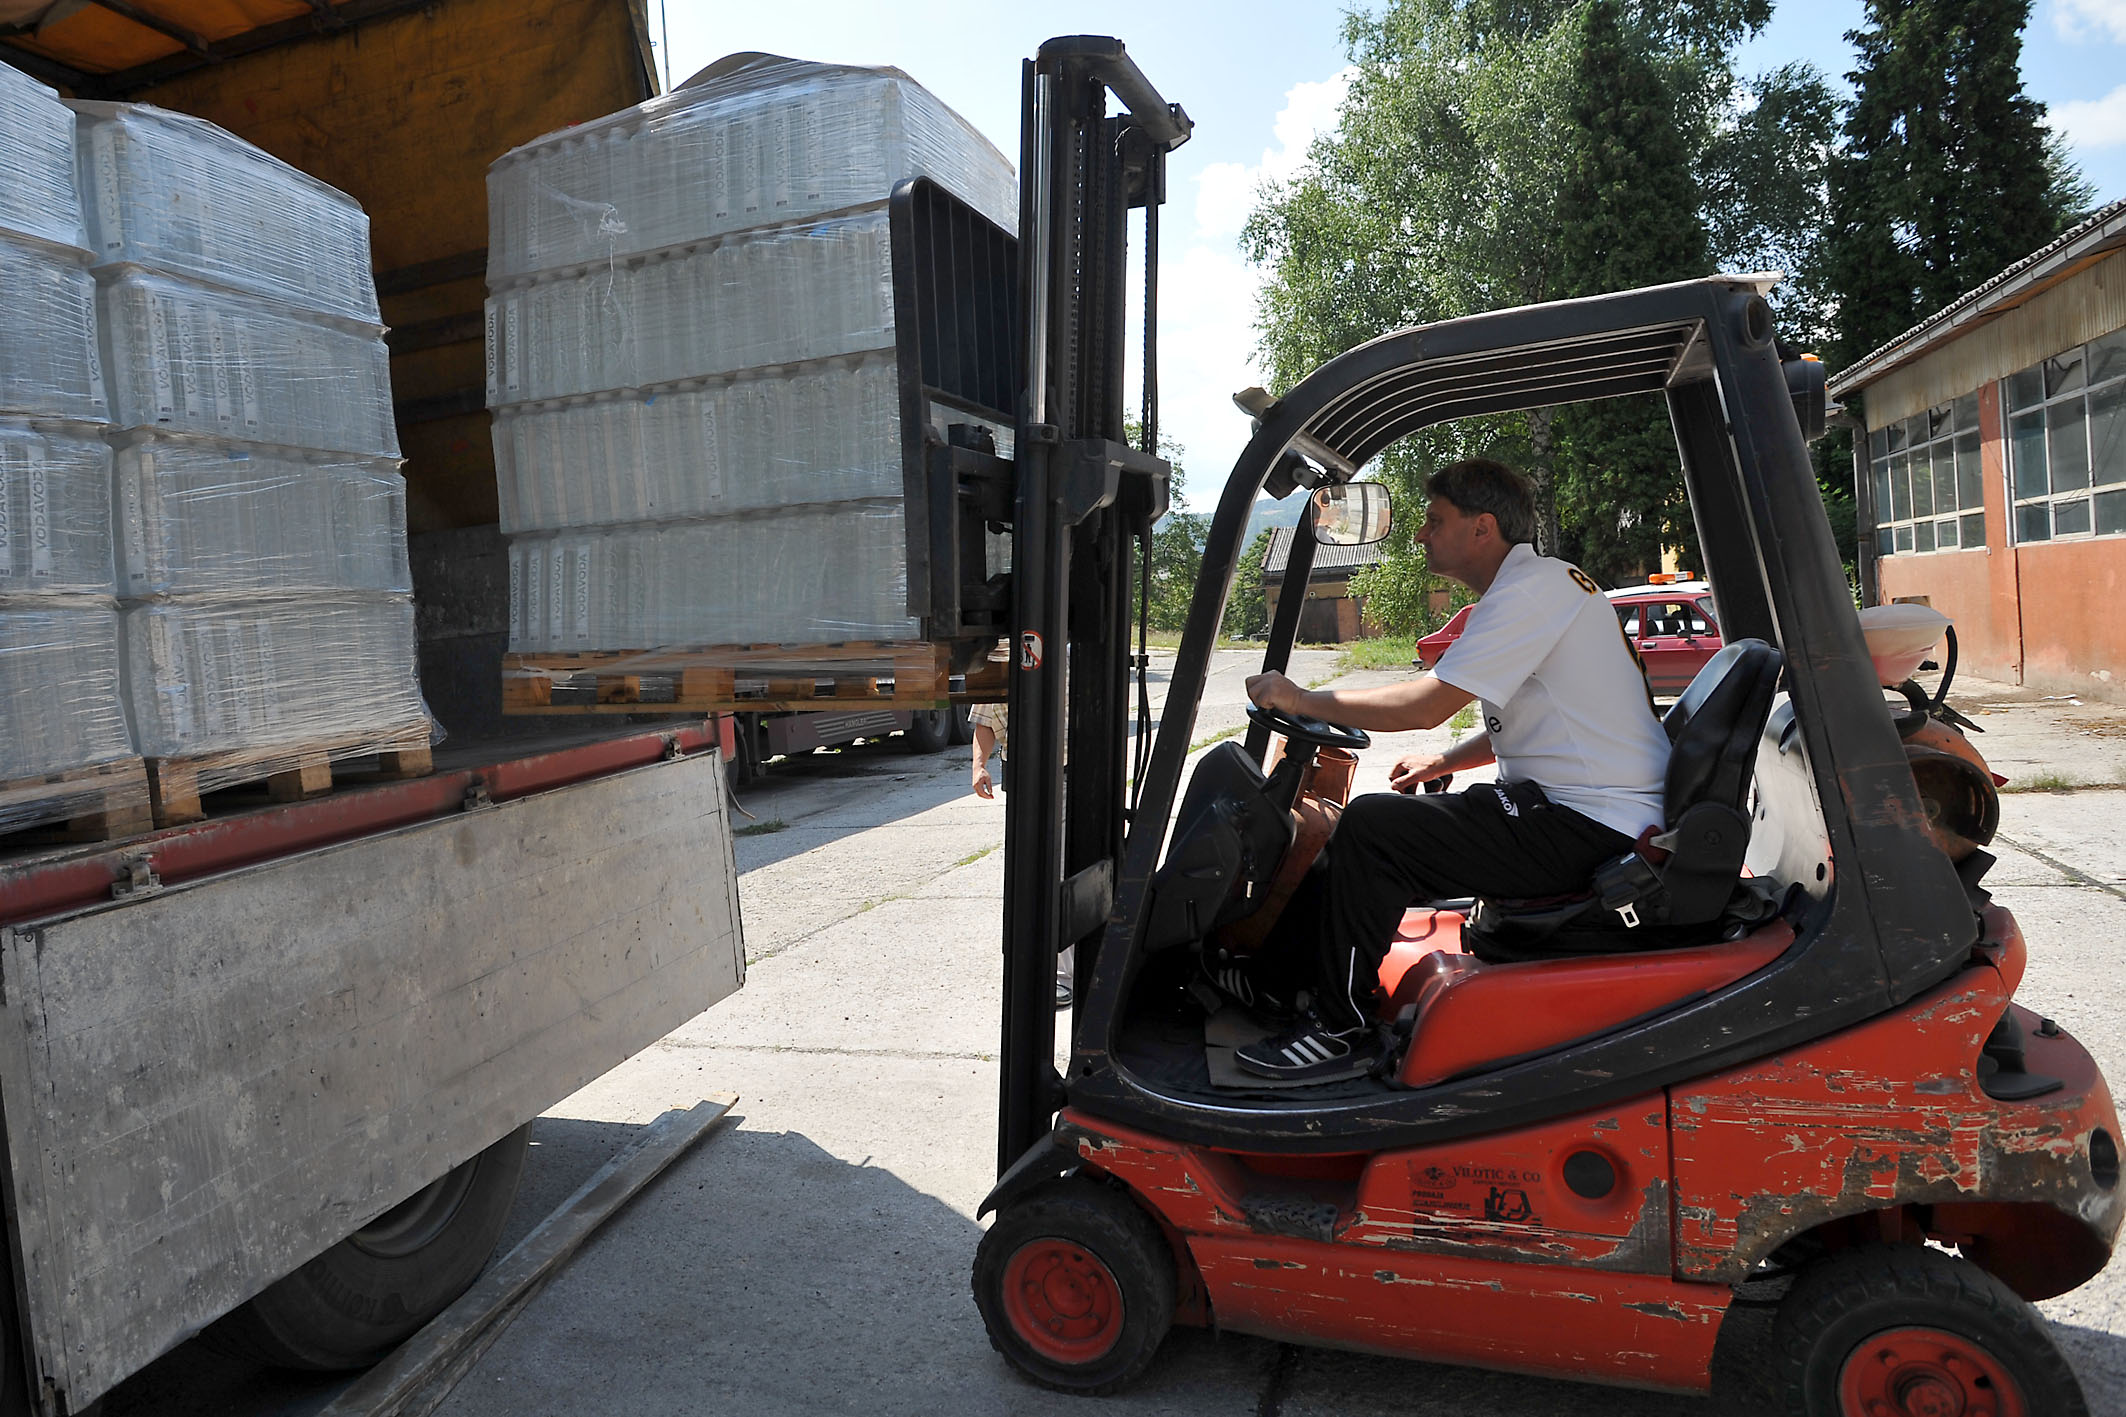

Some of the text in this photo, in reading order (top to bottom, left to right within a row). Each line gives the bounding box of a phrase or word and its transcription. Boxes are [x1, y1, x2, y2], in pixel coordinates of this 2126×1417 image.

[714, 130, 724, 199] VODAVODA
[487, 312, 495, 377] VODAVODA
[507, 307, 516, 372] VODAVODA
[703, 410, 718, 481] VODAVODA
[33, 459, 46, 550] VODAVODA
[511, 561, 519, 625] VODAVODA
[529, 558, 538, 622] VODAVODA
[577, 553, 586, 620] VODAVODA
[1493, 788, 1512, 811] JAKO
[1508, 1170, 1517, 1180] &
[1522, 1171, 1541, 1183] CO
